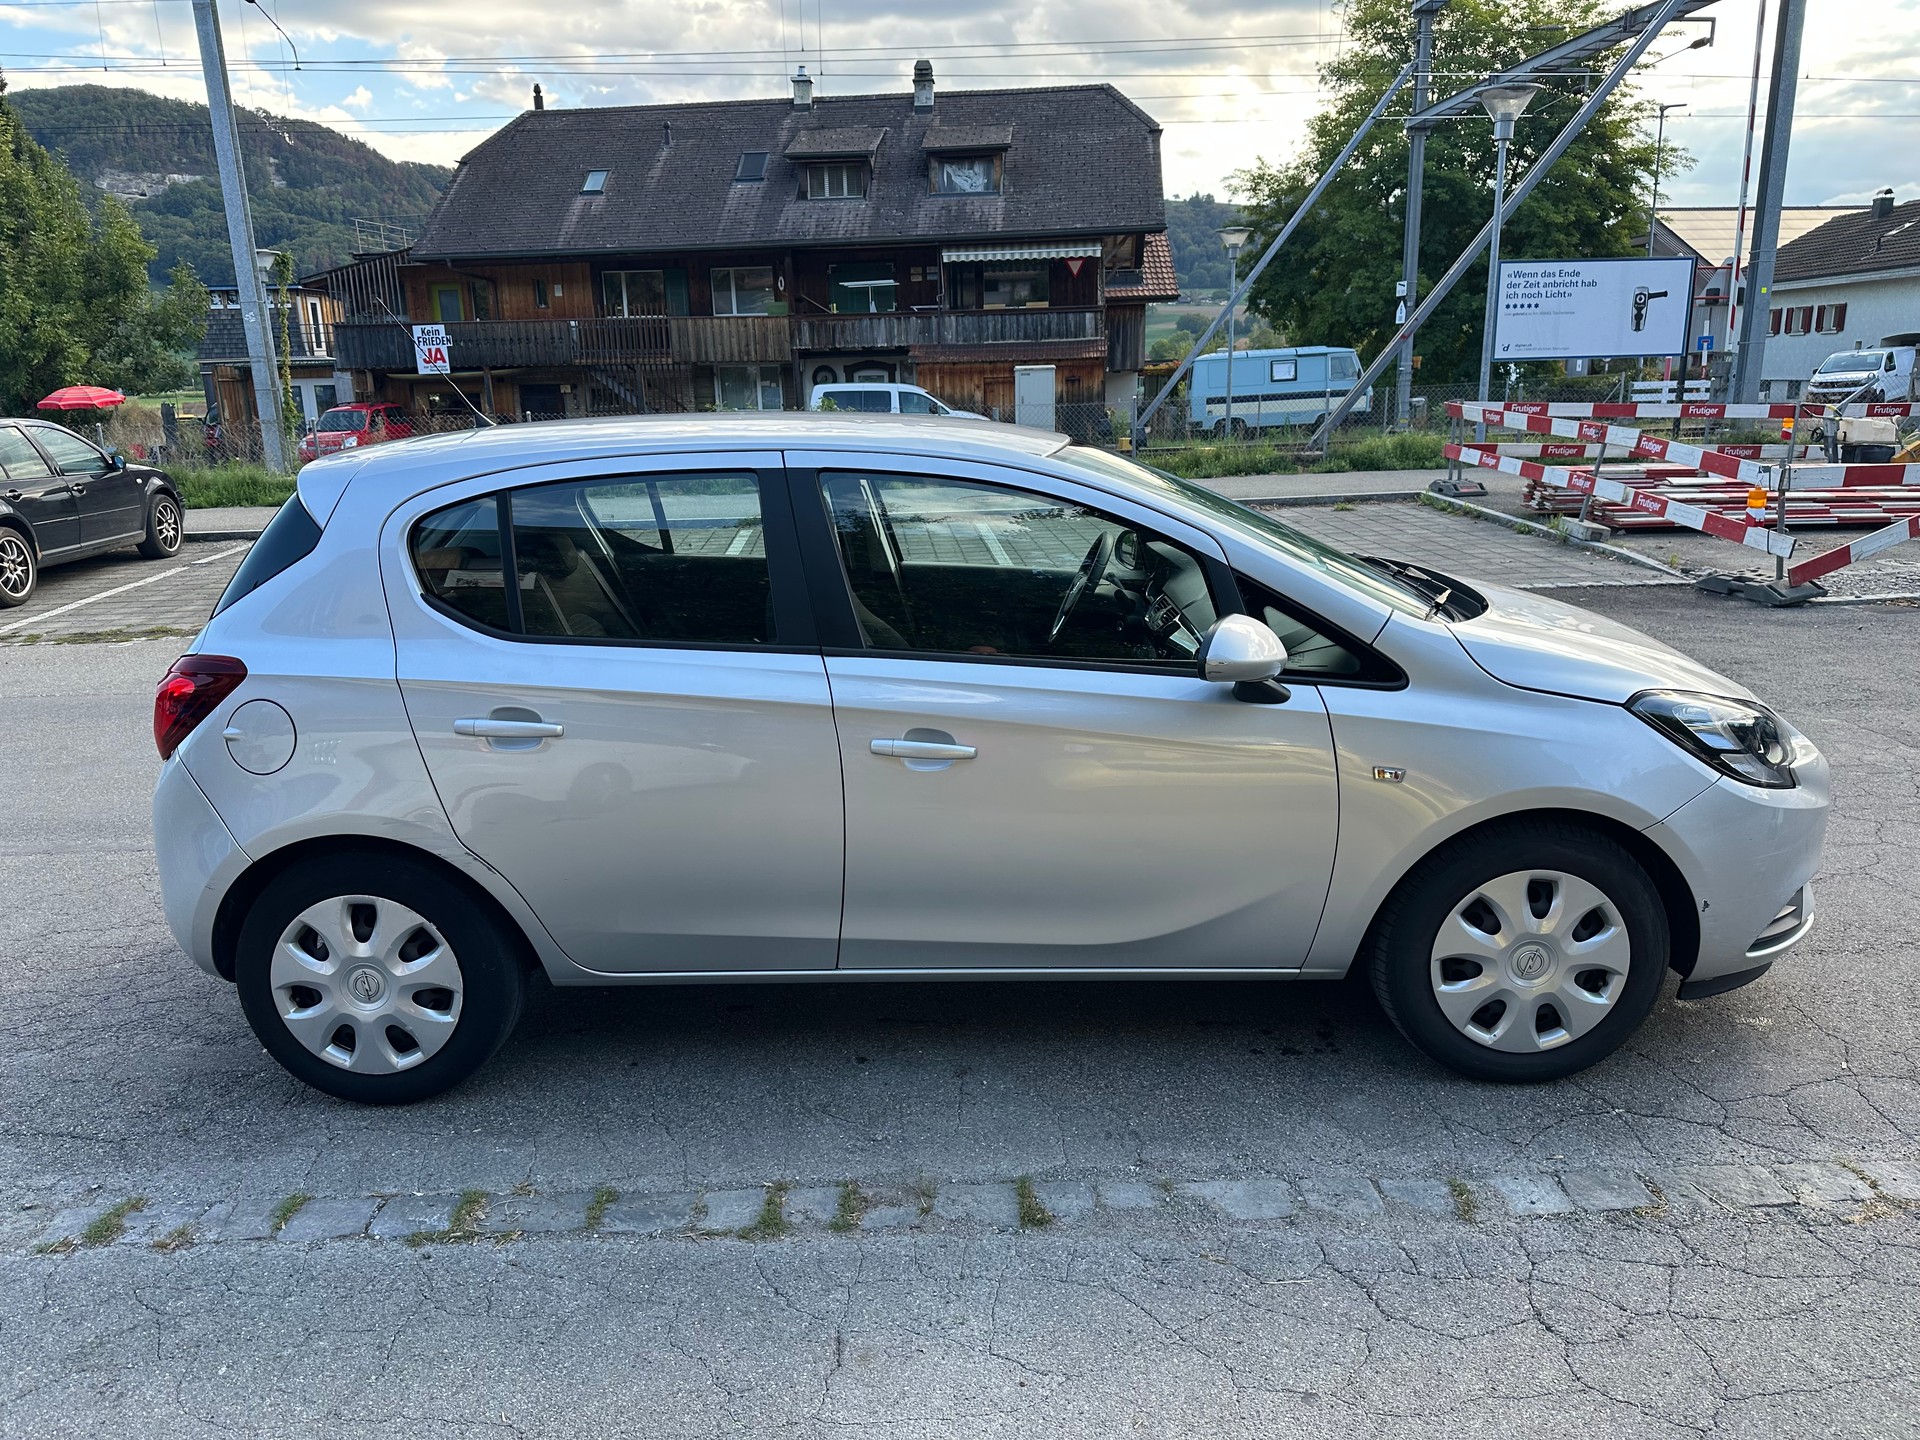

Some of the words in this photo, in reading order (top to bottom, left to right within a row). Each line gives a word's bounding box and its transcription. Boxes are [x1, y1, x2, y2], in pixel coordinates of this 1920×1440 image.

[1540, 269, 1557, 278] das
[1558, 269, 1581, 278] Ende
[1506, 280, 1521, 289] der
[1523, 280, 1541, 289] Zeit
[1542, 279, 1579, 288] anbricht
[1580, 279, 1598, 288] hab
[1505, 291, 1519, 299] ich
[1521, 290, 1543, 299] noch
[420, 326, 440, 337] Kein
[417, 335, 452, 347] FRIEDEN
[422, 347, 447, 365] JA
[1511, 403, 1541, 414] Frutiger
[1689, 405, 1719, 416] Frutiger
[1873, 405, 1904, 415] Frutiger
[1485, 411, 1501, 422] Frutiger
[1547, 445, 1578, 456] Frutiger
[1640, 437, 1663, 454] Frutiger
[1724, 446, 1754, 457] Frutiger
[1481, 454, 1497, 466] Frutiger
[1636, 495, 1661, 512] Frutiger
